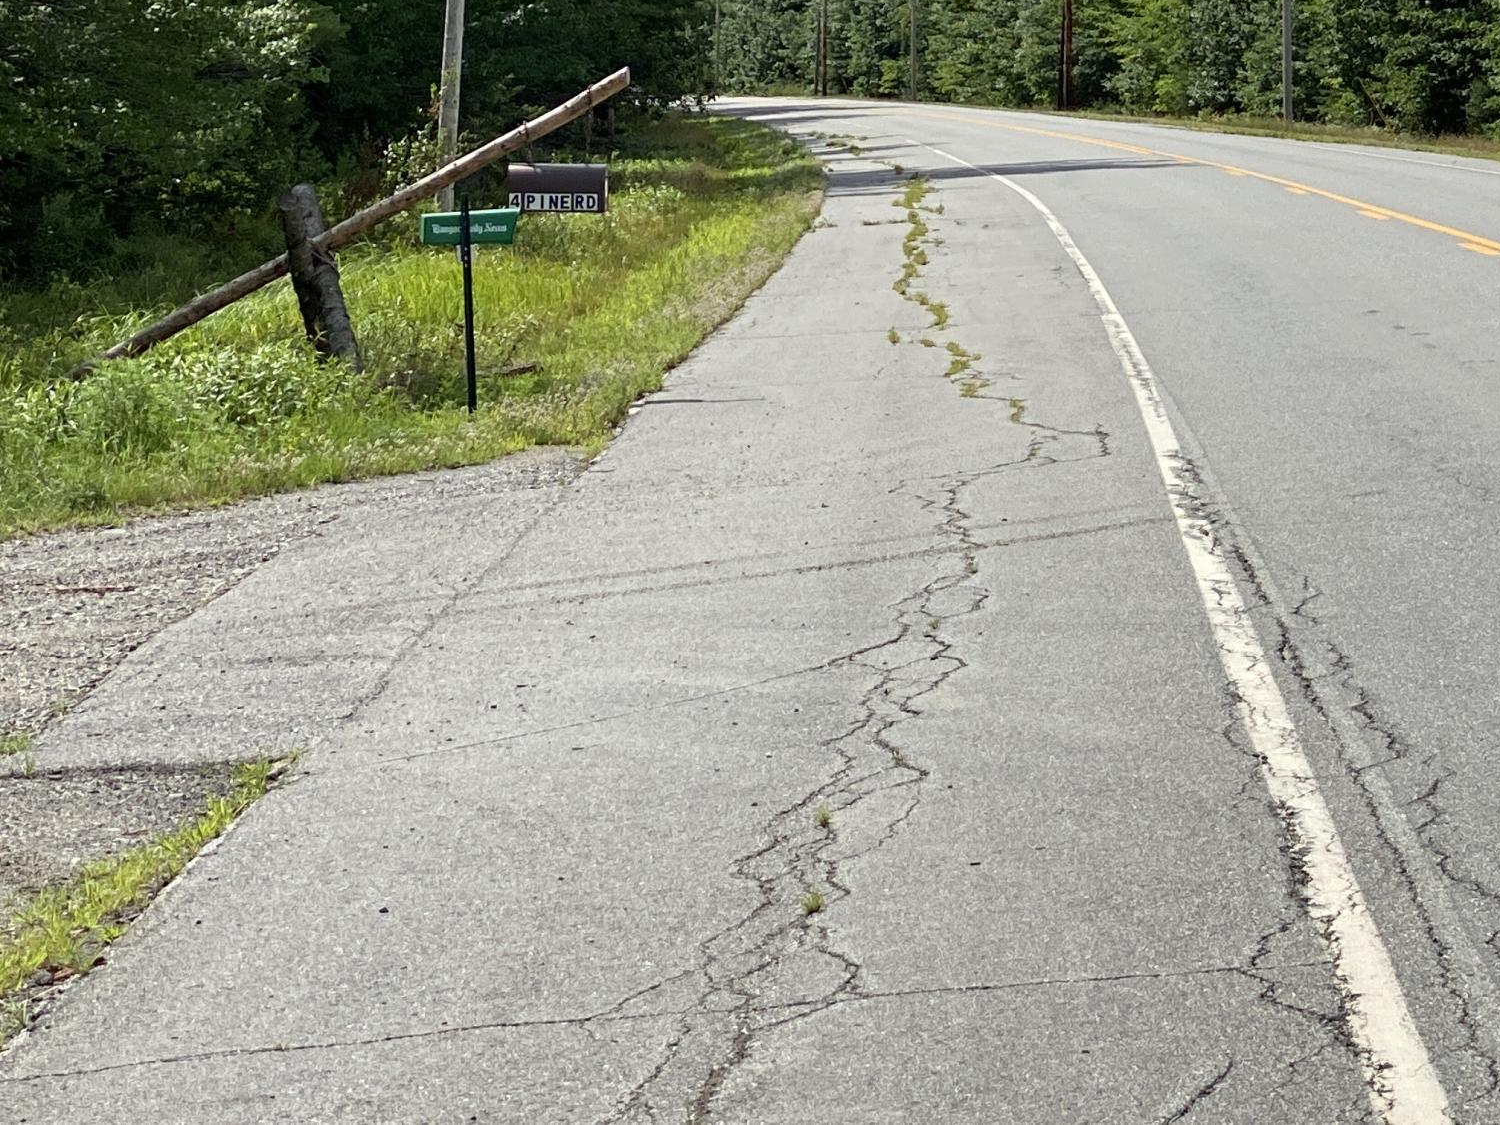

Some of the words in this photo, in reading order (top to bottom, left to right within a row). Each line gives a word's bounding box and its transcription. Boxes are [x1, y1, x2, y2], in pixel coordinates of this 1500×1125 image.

[510, 194, 520, 208] 4
[526, 194, 570, 209] PINE
[575, 195, 597, 209] RD
